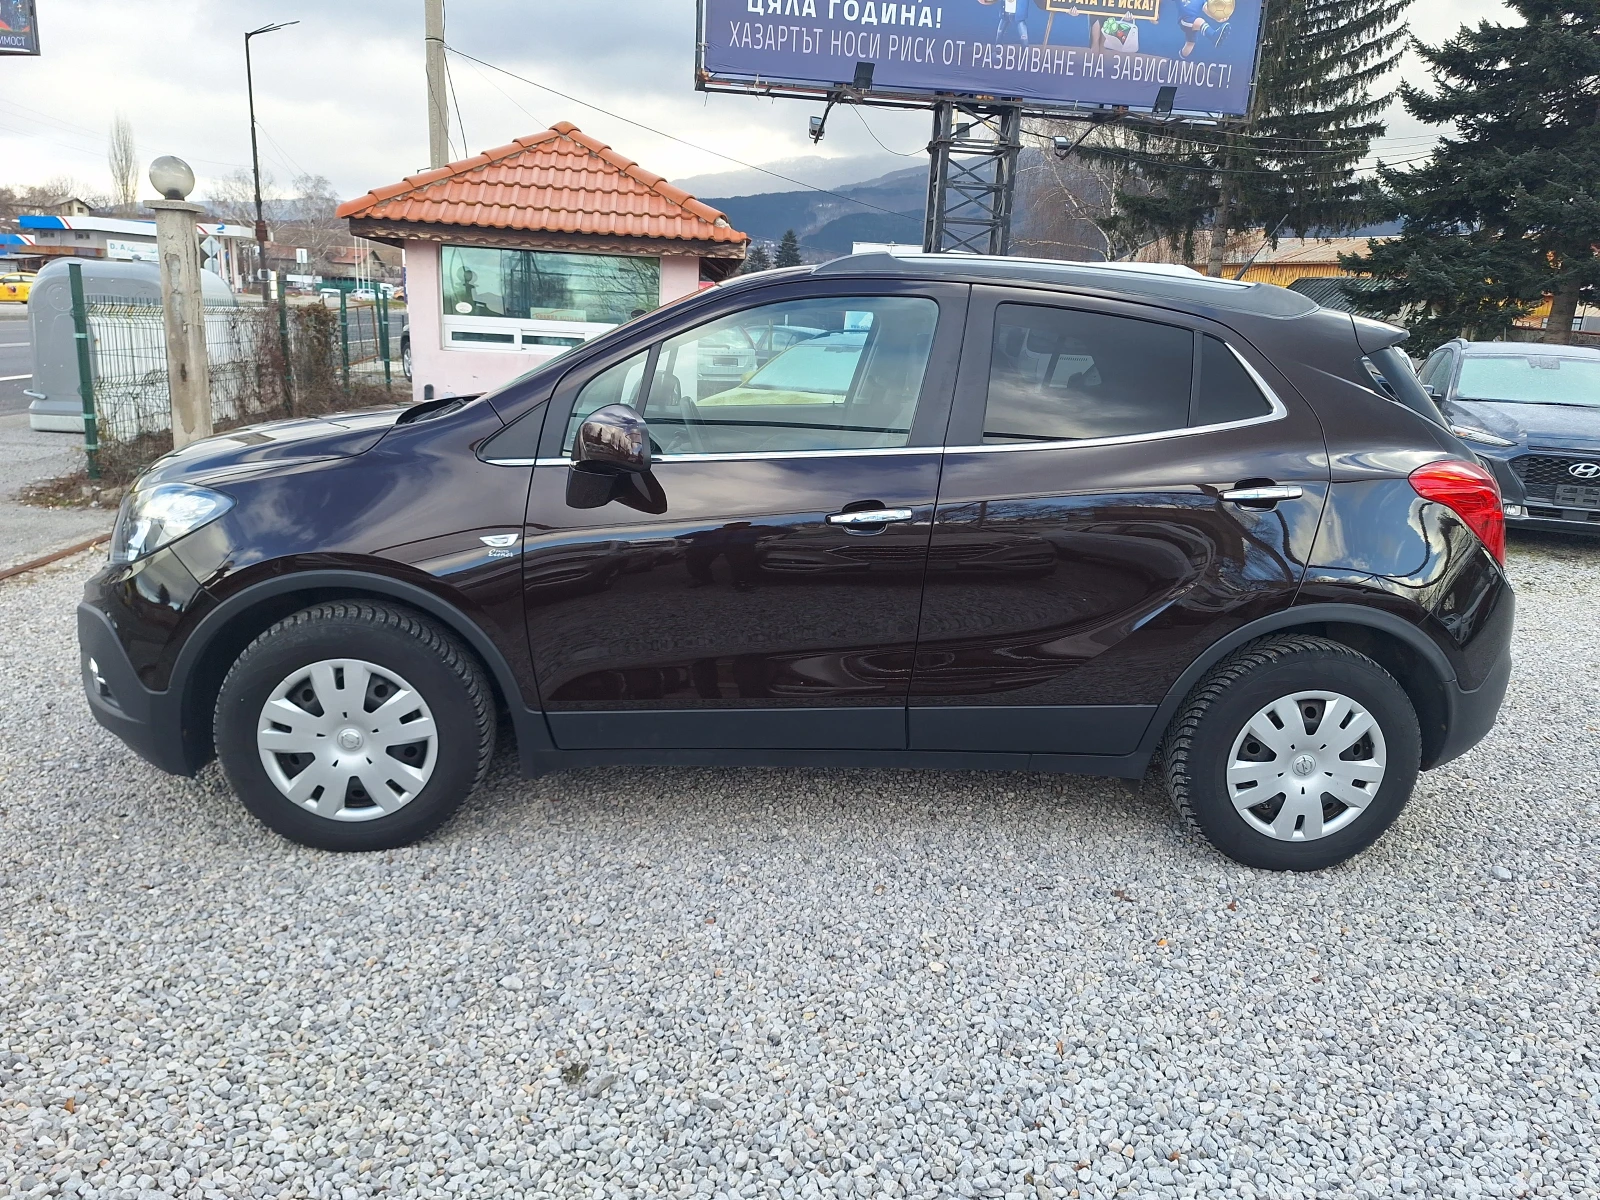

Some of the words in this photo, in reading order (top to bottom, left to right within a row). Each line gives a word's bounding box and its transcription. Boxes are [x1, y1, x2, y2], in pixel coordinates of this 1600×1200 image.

[747, 0, 817, 18] ЦЯЛА
[828, 0, 943, 29] ГОДИНА!
[729, 20, 824, 55] ХАЗАРТЪТ
[830, 29, 881, 59] НОСИ
[888, 34, 935, 64] РИСК
[942, 39, 966, 66] ОТ
[971, 42, 1075, 76] РАЗВИВАНЕ
[1083, 52, 1105, 79] НА
[1110, 54, 1233, 89] ЗАВИСИМОСТ!
